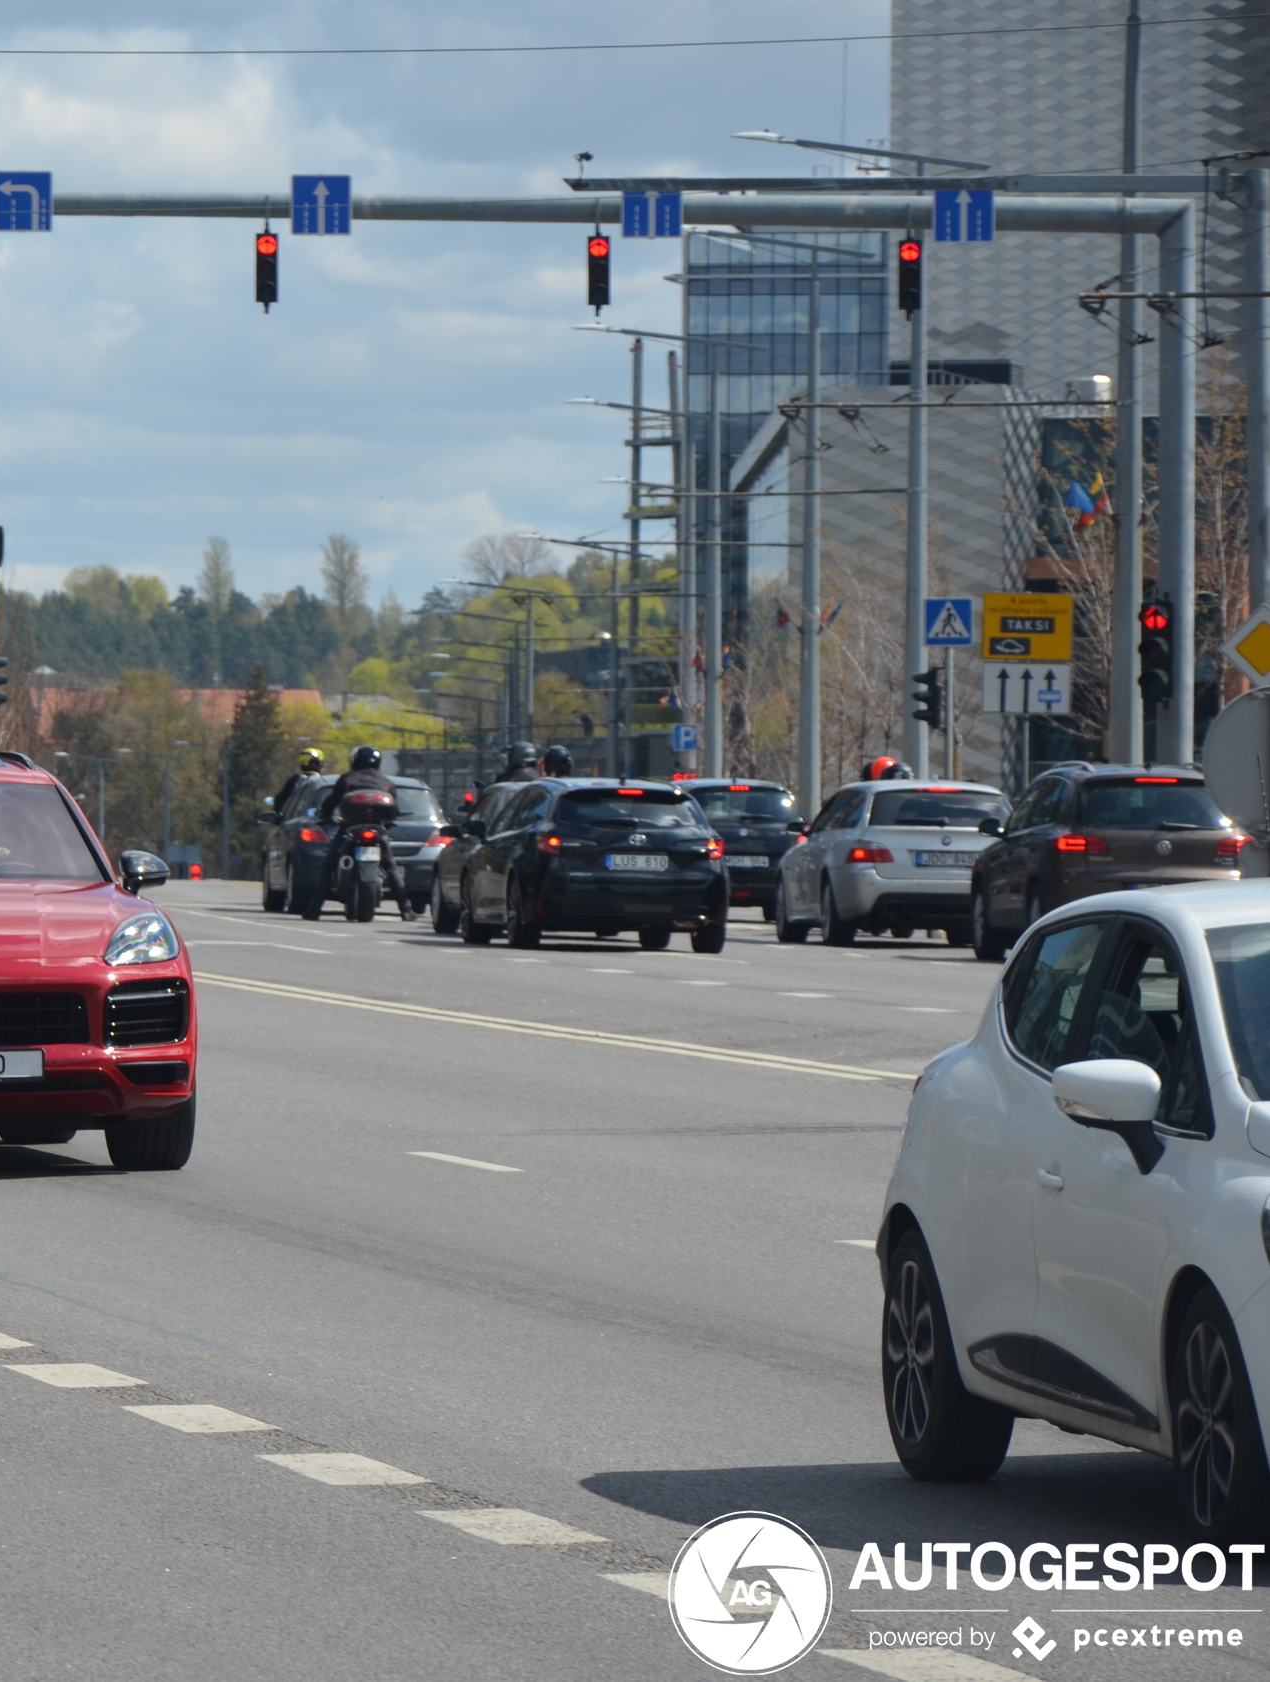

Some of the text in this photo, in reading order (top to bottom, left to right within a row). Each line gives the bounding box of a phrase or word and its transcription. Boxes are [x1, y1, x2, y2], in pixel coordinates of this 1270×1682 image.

[1007, 620, 1049, 630] TAKSI
[681, 726, 694, 749] P
[613, 856, 638, 867] LUS
[645, 856, 667, 867] 610
